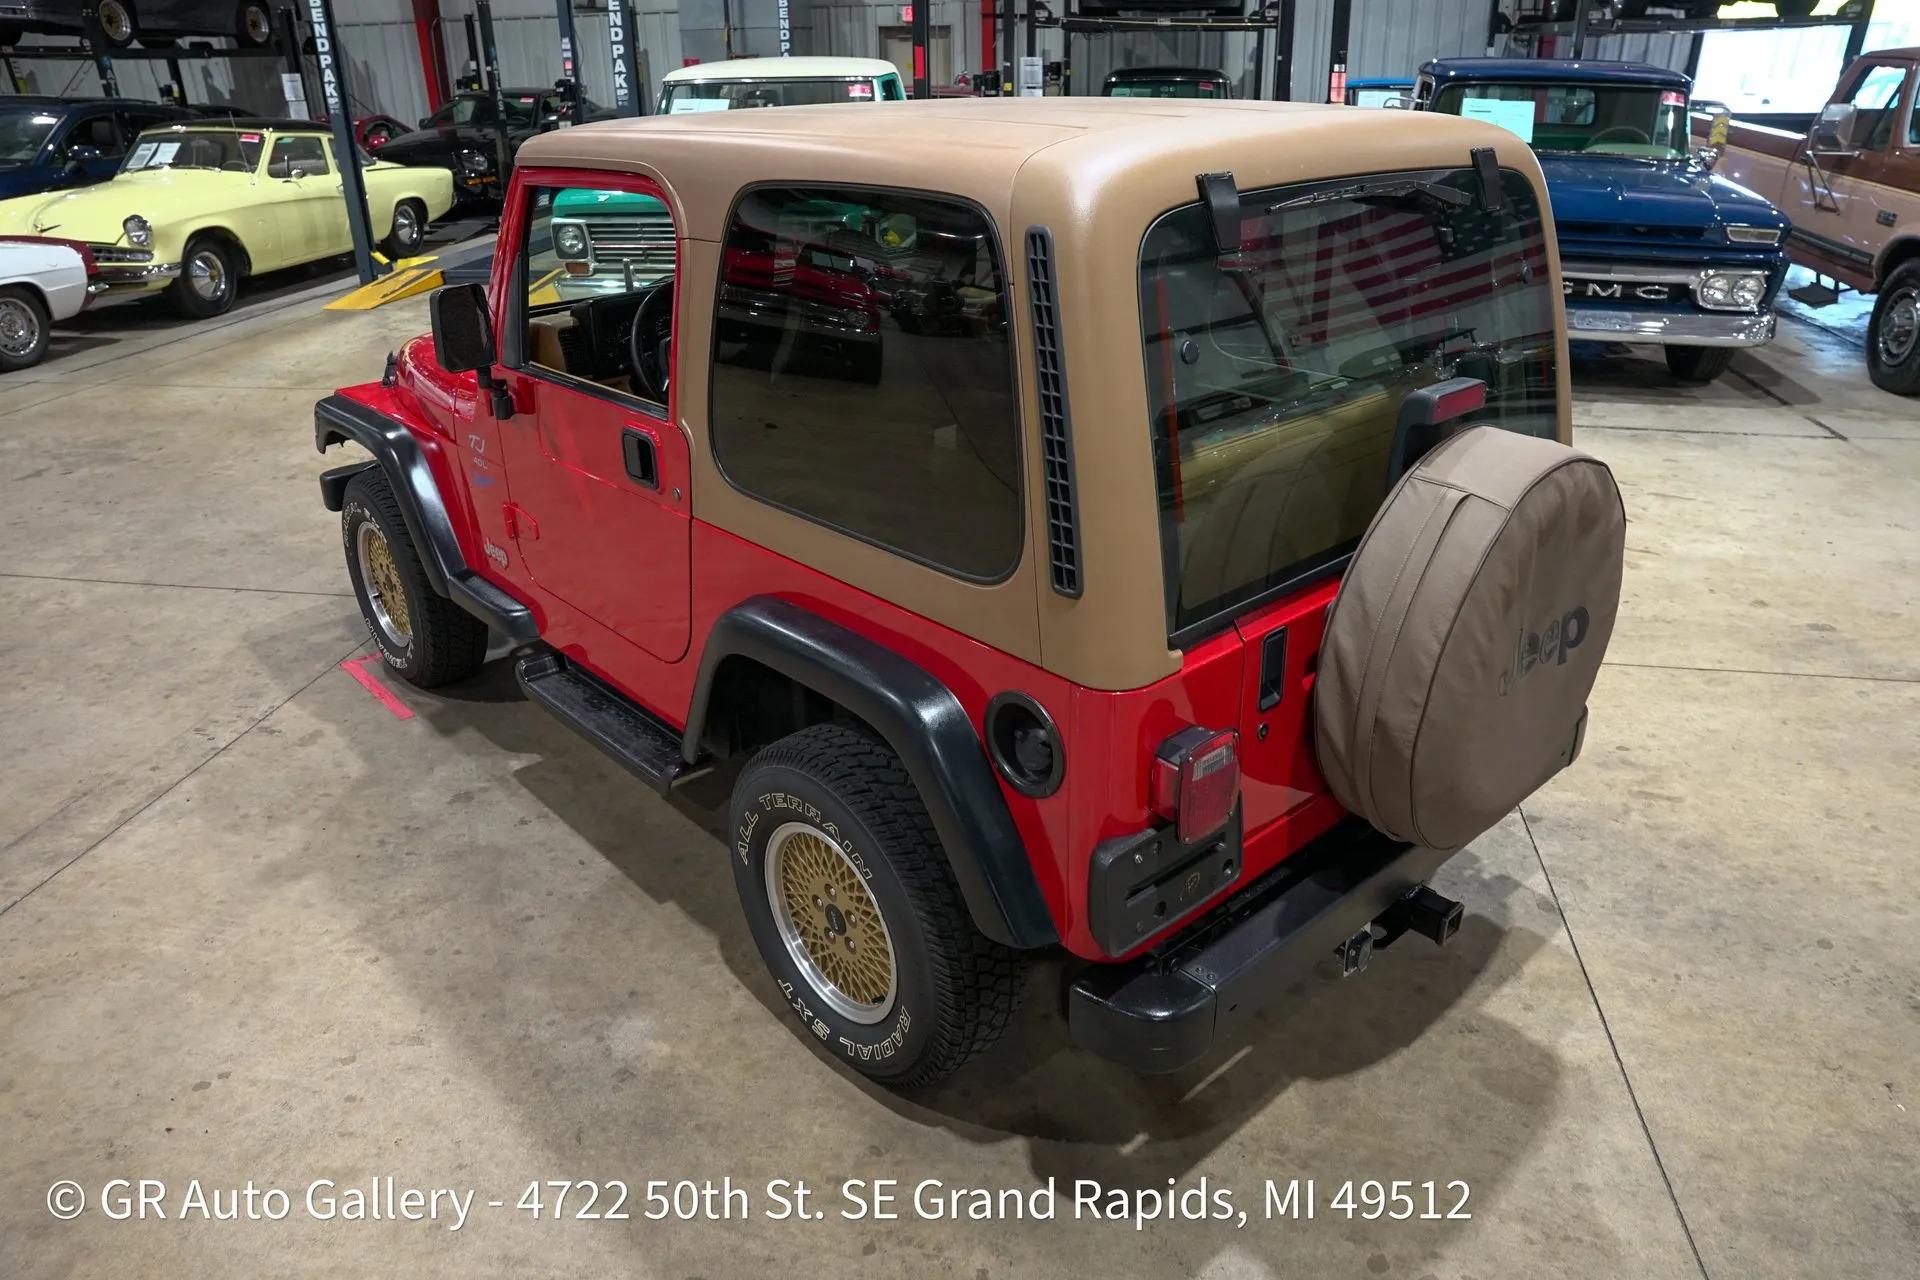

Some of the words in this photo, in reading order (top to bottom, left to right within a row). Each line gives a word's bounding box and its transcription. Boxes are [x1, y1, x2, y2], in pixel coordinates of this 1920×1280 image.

[309, 0, 338, 97] BENDPAK
[483, 537, 508, 569] Jeep
[736, 811, 760, 866] ALL
[759, 793, 873, 880] TERRAIN
[777, 979, 831, 1041] SXT
[840, 1005, 912, 1061] RADIAL
